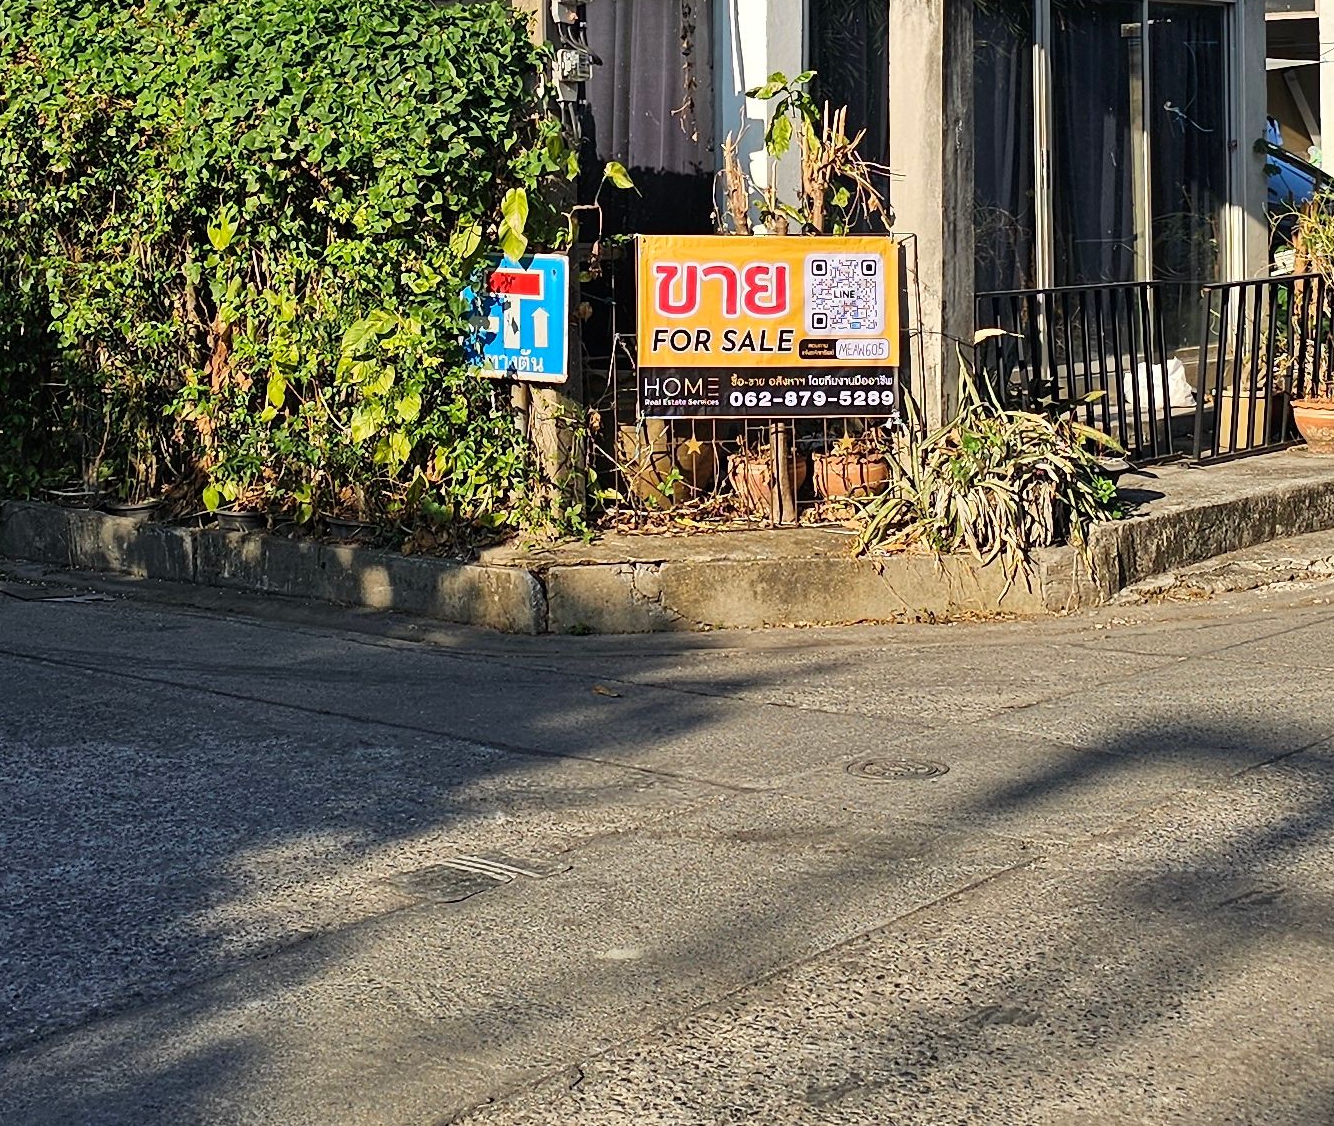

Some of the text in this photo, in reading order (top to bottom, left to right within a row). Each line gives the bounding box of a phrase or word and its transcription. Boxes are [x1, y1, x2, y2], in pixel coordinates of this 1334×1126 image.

[653, 262, 788, 317] ขาย
[833, 289, 856, 299] LINE
[652, 329, 794, 352] FOR SALE
[644, 377, 719, 396] HOME
[644, 398, 719, 406] Real Estate Services
[729, 390, 894, 407] 062-879-5289
